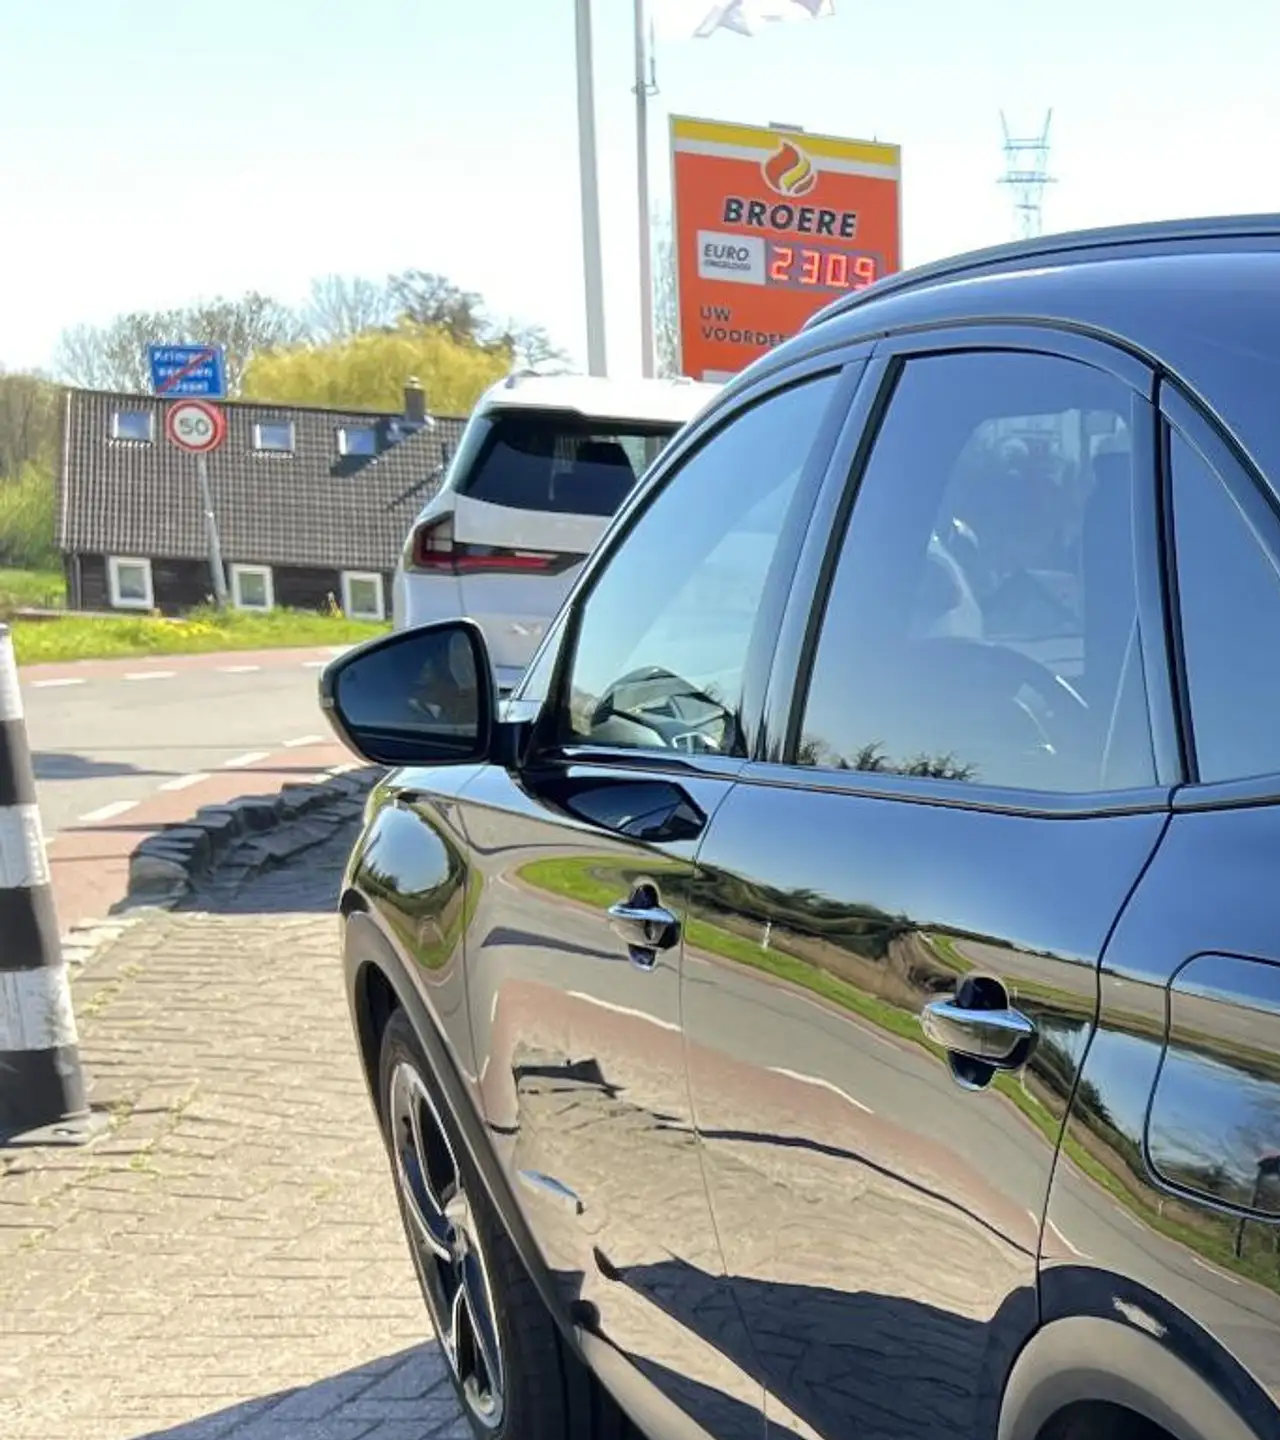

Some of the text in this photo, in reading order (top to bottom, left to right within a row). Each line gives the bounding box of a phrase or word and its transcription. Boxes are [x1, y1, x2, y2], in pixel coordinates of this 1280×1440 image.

[723, 197, 857, 237] BROERE
[704, 243, 749, 260] EURO
[700, 305, 731, 322] UW
[179, 417, 210, 436] 50
